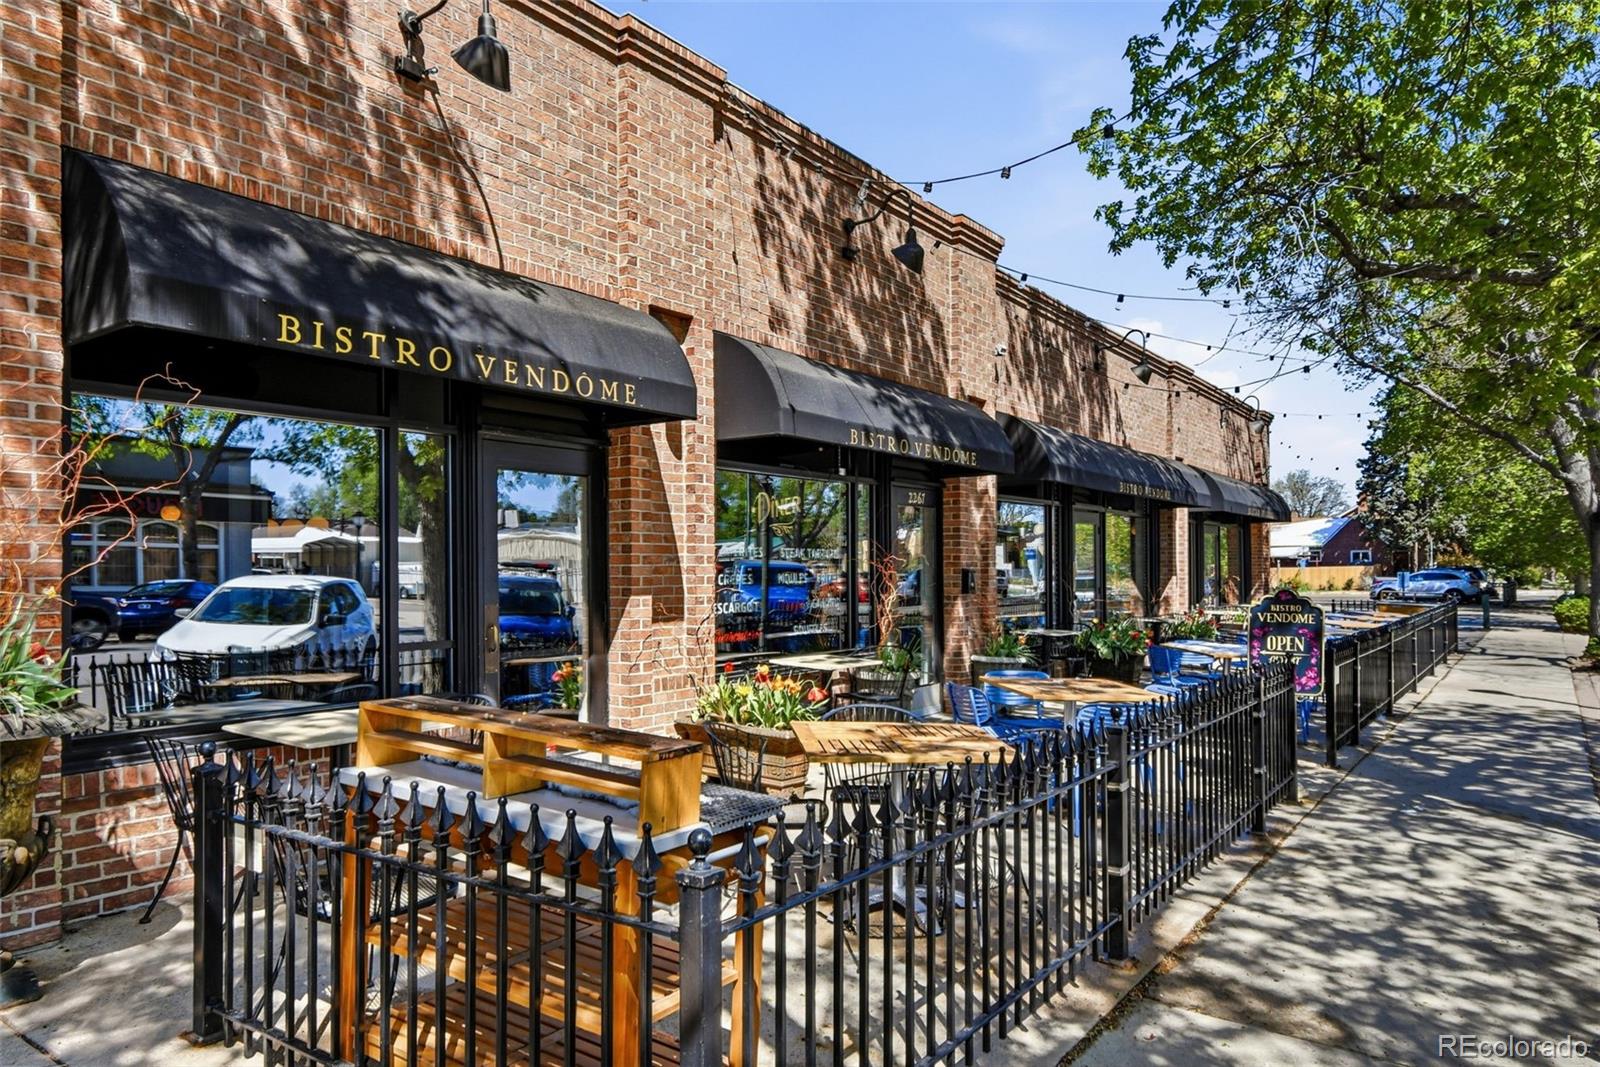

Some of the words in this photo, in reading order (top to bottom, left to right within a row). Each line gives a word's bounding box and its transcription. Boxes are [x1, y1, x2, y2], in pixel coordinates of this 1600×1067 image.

[277, 313, 452, 373] BISTRO
[475, 353, 637, 406] VENDÔME
[849, 428, 910, 455] BISTRO
[1119, 481, 1143, 496] BISTRO
[779, 547, 805, 559] STEAK
[777, 572, 808, 585] MOULES
[1270, 604, 1302, 612] BISTRO
[1257, 612, 1317, 624] VENDOME
[1267, 636, 1305, 652] OPEN
